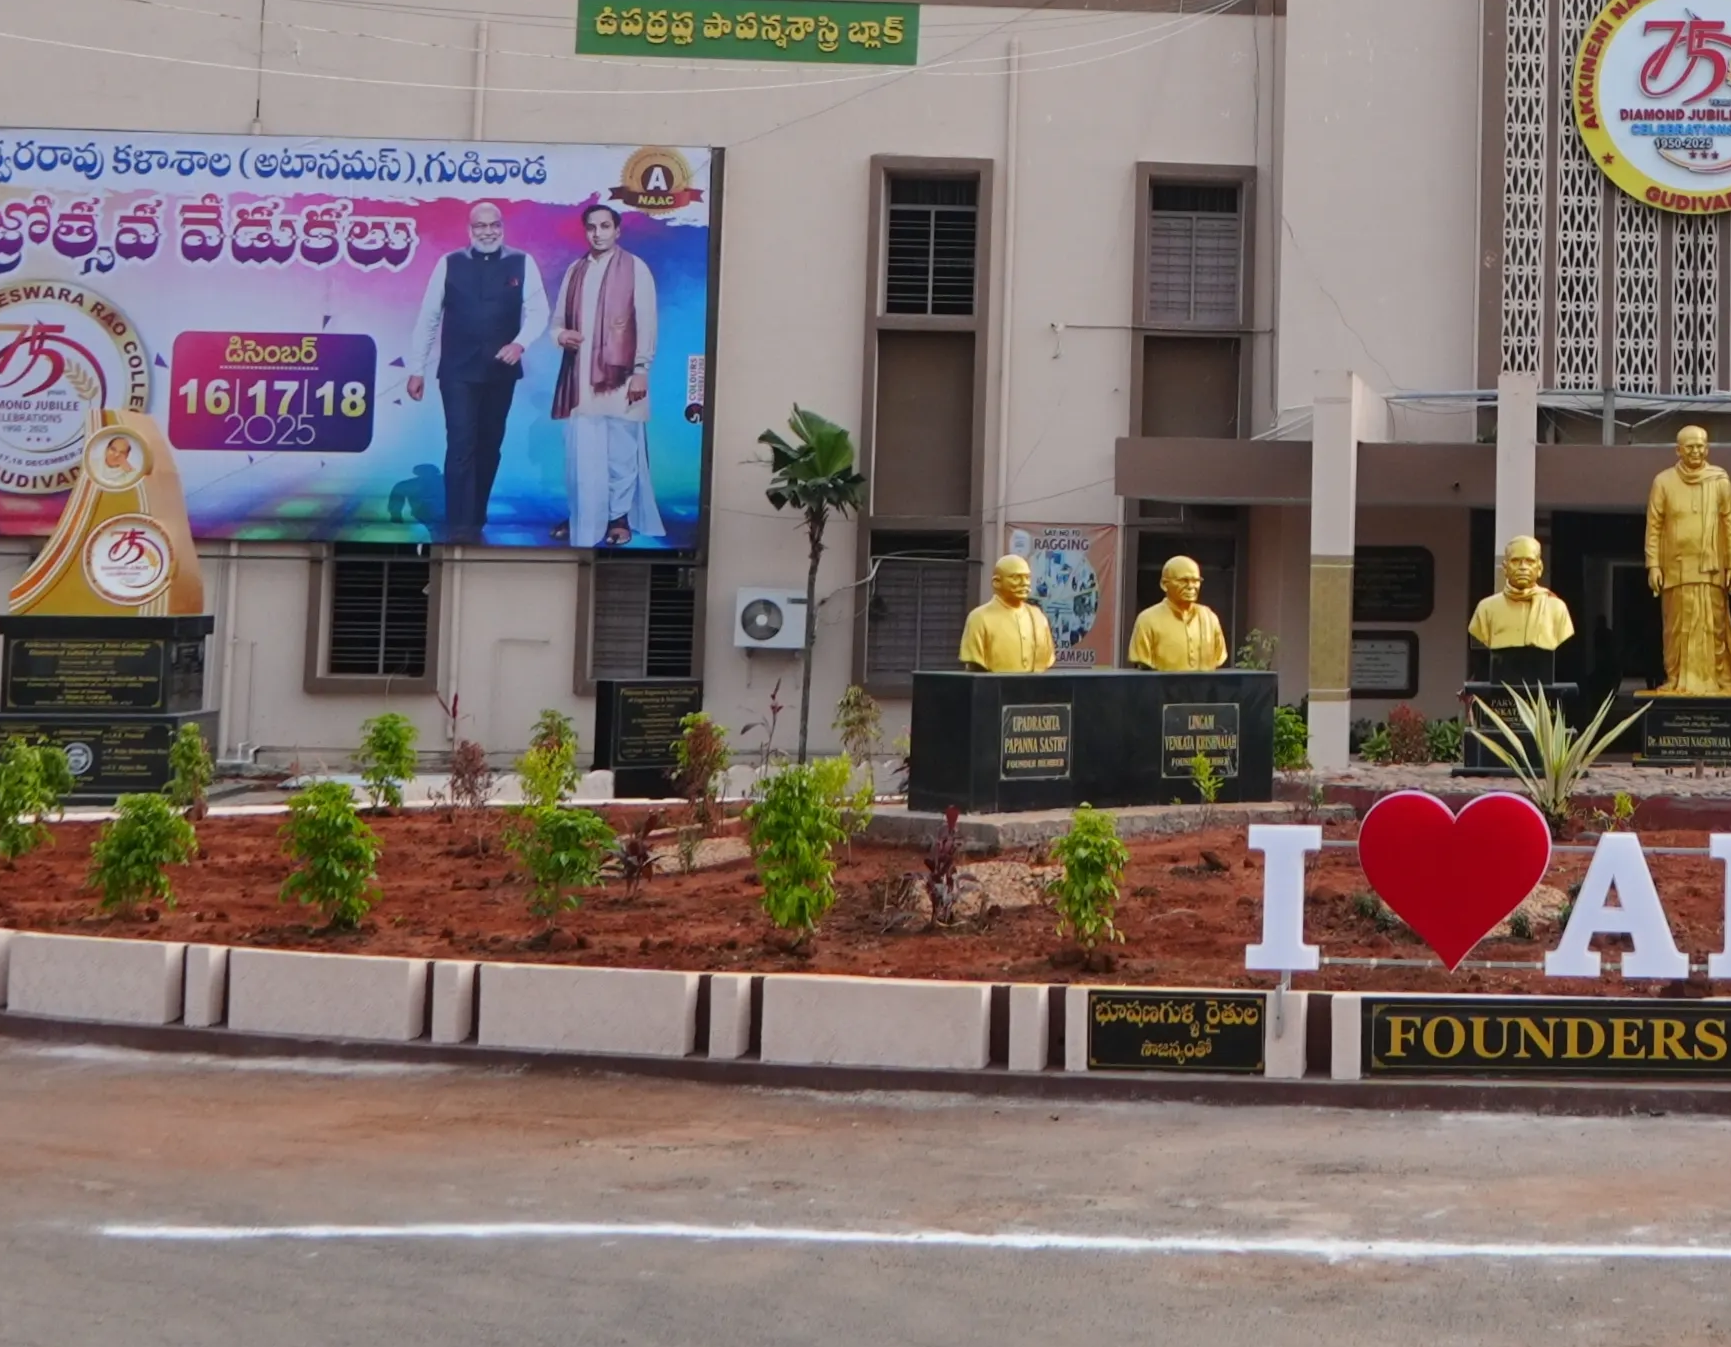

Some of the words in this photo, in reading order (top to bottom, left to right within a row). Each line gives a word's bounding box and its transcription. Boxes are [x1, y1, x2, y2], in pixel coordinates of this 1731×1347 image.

[1576, 19, 1613, 130] AKKINENI
[1653, 137, 1714, 151] 1950-2025
[112, 144, 233, 179] కళాశాల
[646, 166, 668, 190] A
[637, 193, 675, 206] NAAC
[178, 192, 419, 273] వేడుకలు
[90, 301, 128, 337] RAO
[123, 340, 146, 413] COLLE
[225, 336, 318, 364] డిసెంబర్
[34, 400, 80, 412] JUBILEE
[224, 413, 316, 445] 2025
[1034, 538, 1089, 551] RAGGING
[1244, 822, 1323, 972] I
[1204, 1000, 1259, 1034] రైతుల
[1387, 1014, 1729, 1064] FOUNDERS
